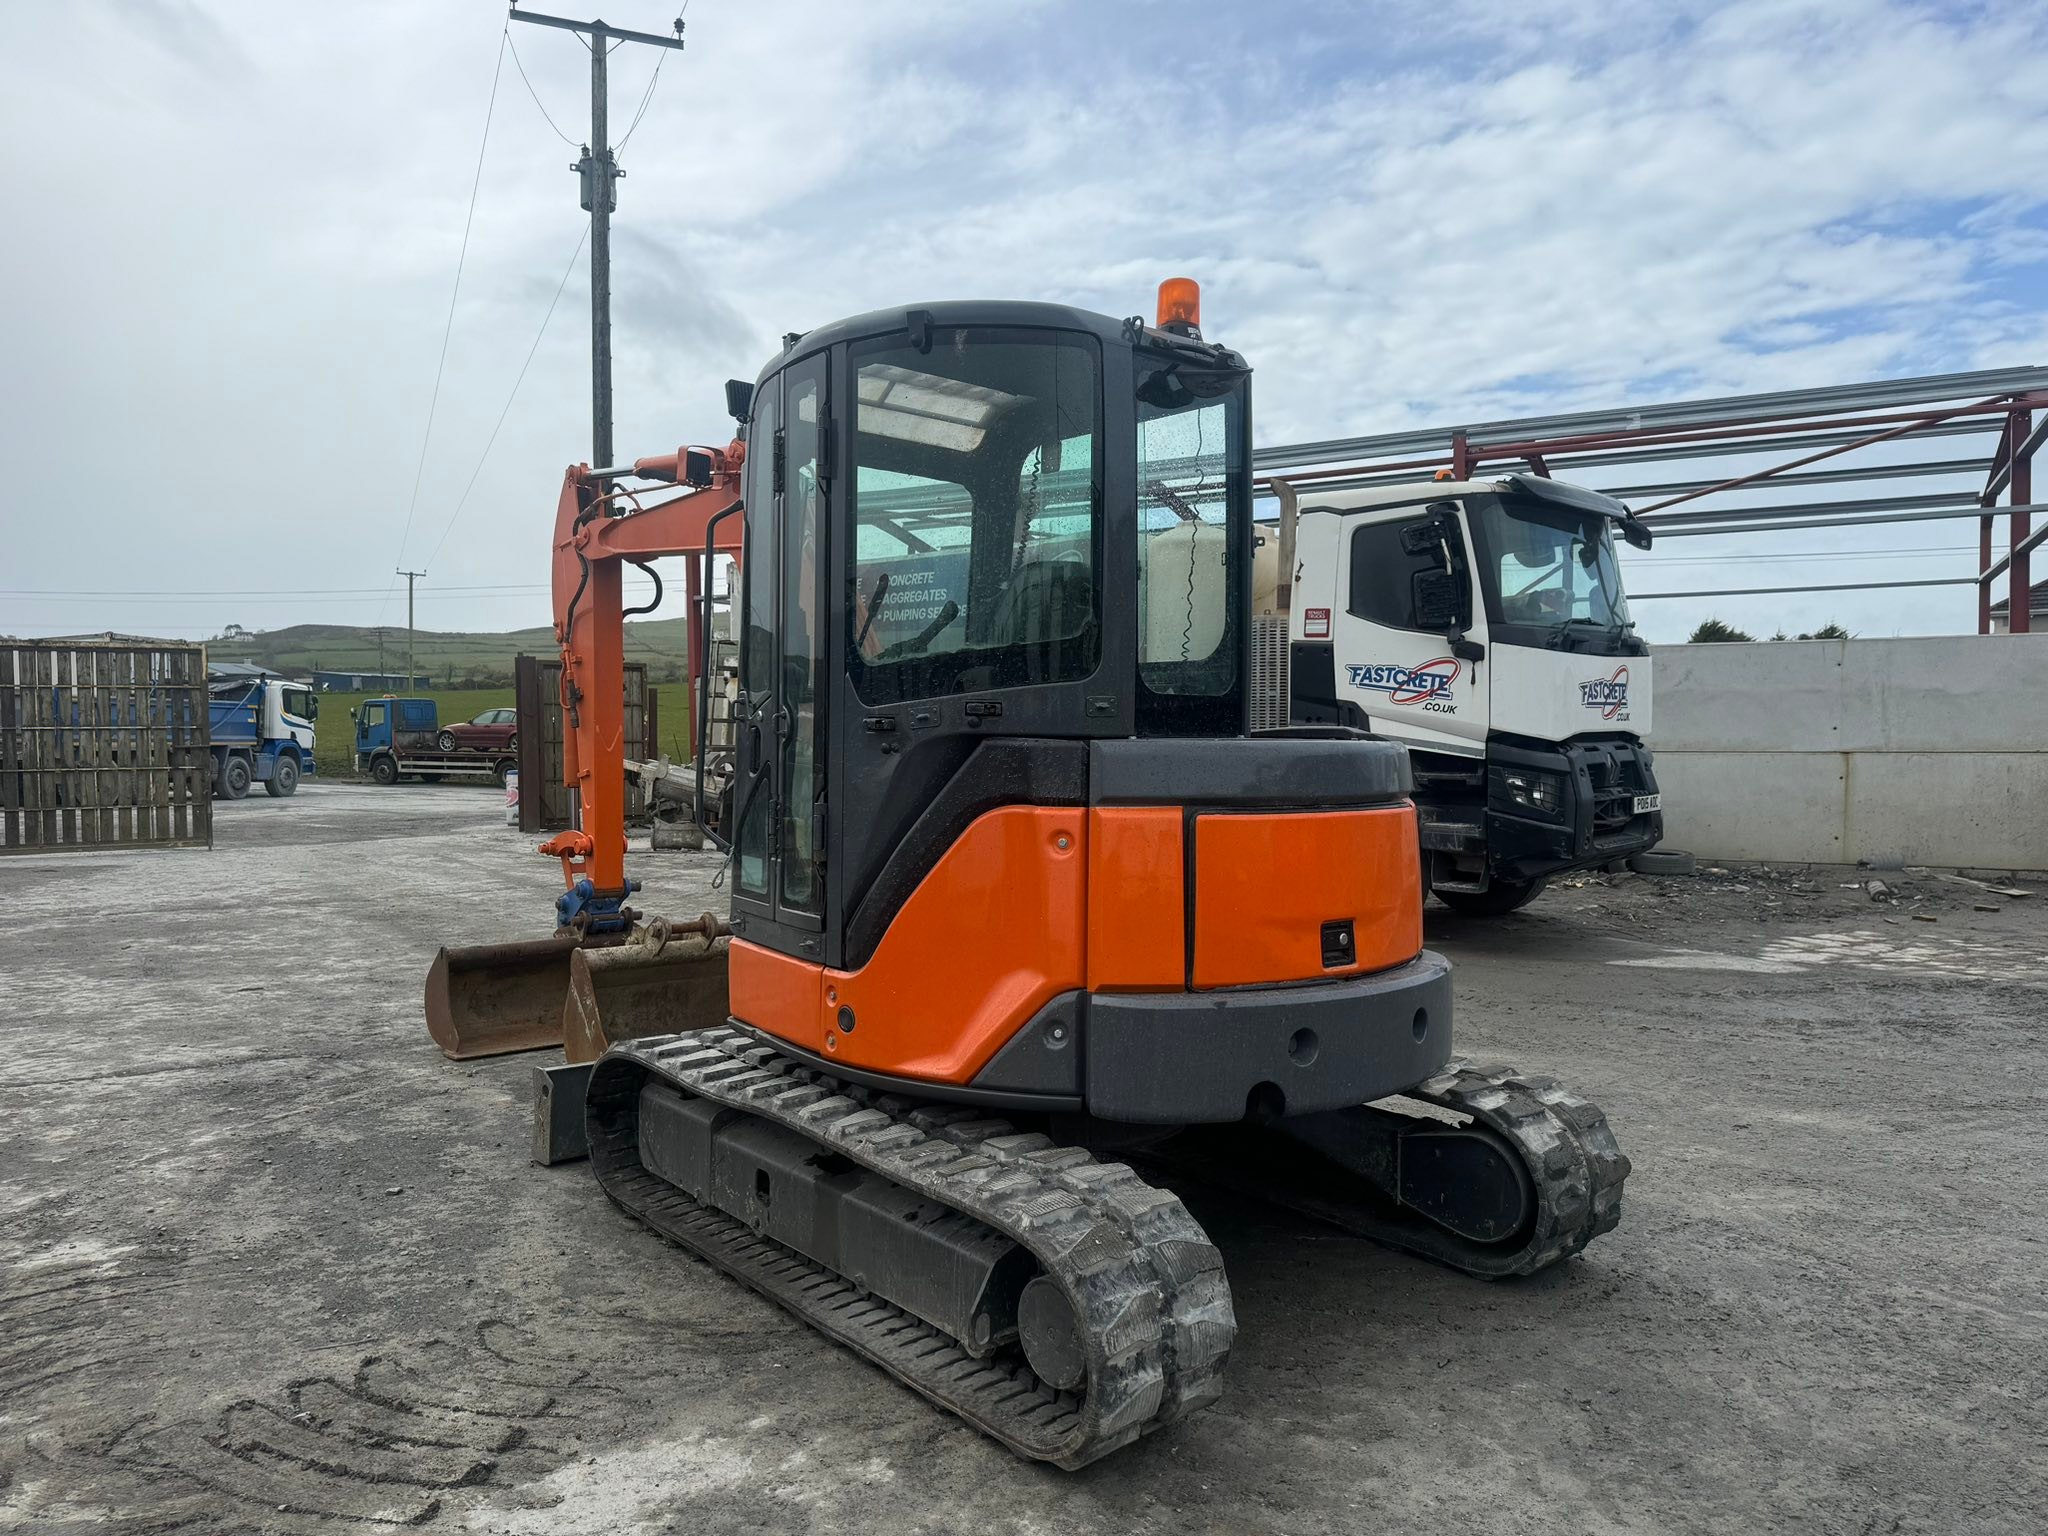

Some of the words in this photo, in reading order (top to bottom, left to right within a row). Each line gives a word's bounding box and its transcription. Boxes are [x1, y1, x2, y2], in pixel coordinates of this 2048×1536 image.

[886, 571, 935, 587] ONCRETE
[882, 588, 948, 605] AGGREGATES
[883, 607, 927, 622] PUMPING
[1348, 665, 1452, 692] FASTCRETE
[1580, 681, 1627, 702] FASTCRETE
[1422, 702, 1458, 715] .CO.UK
